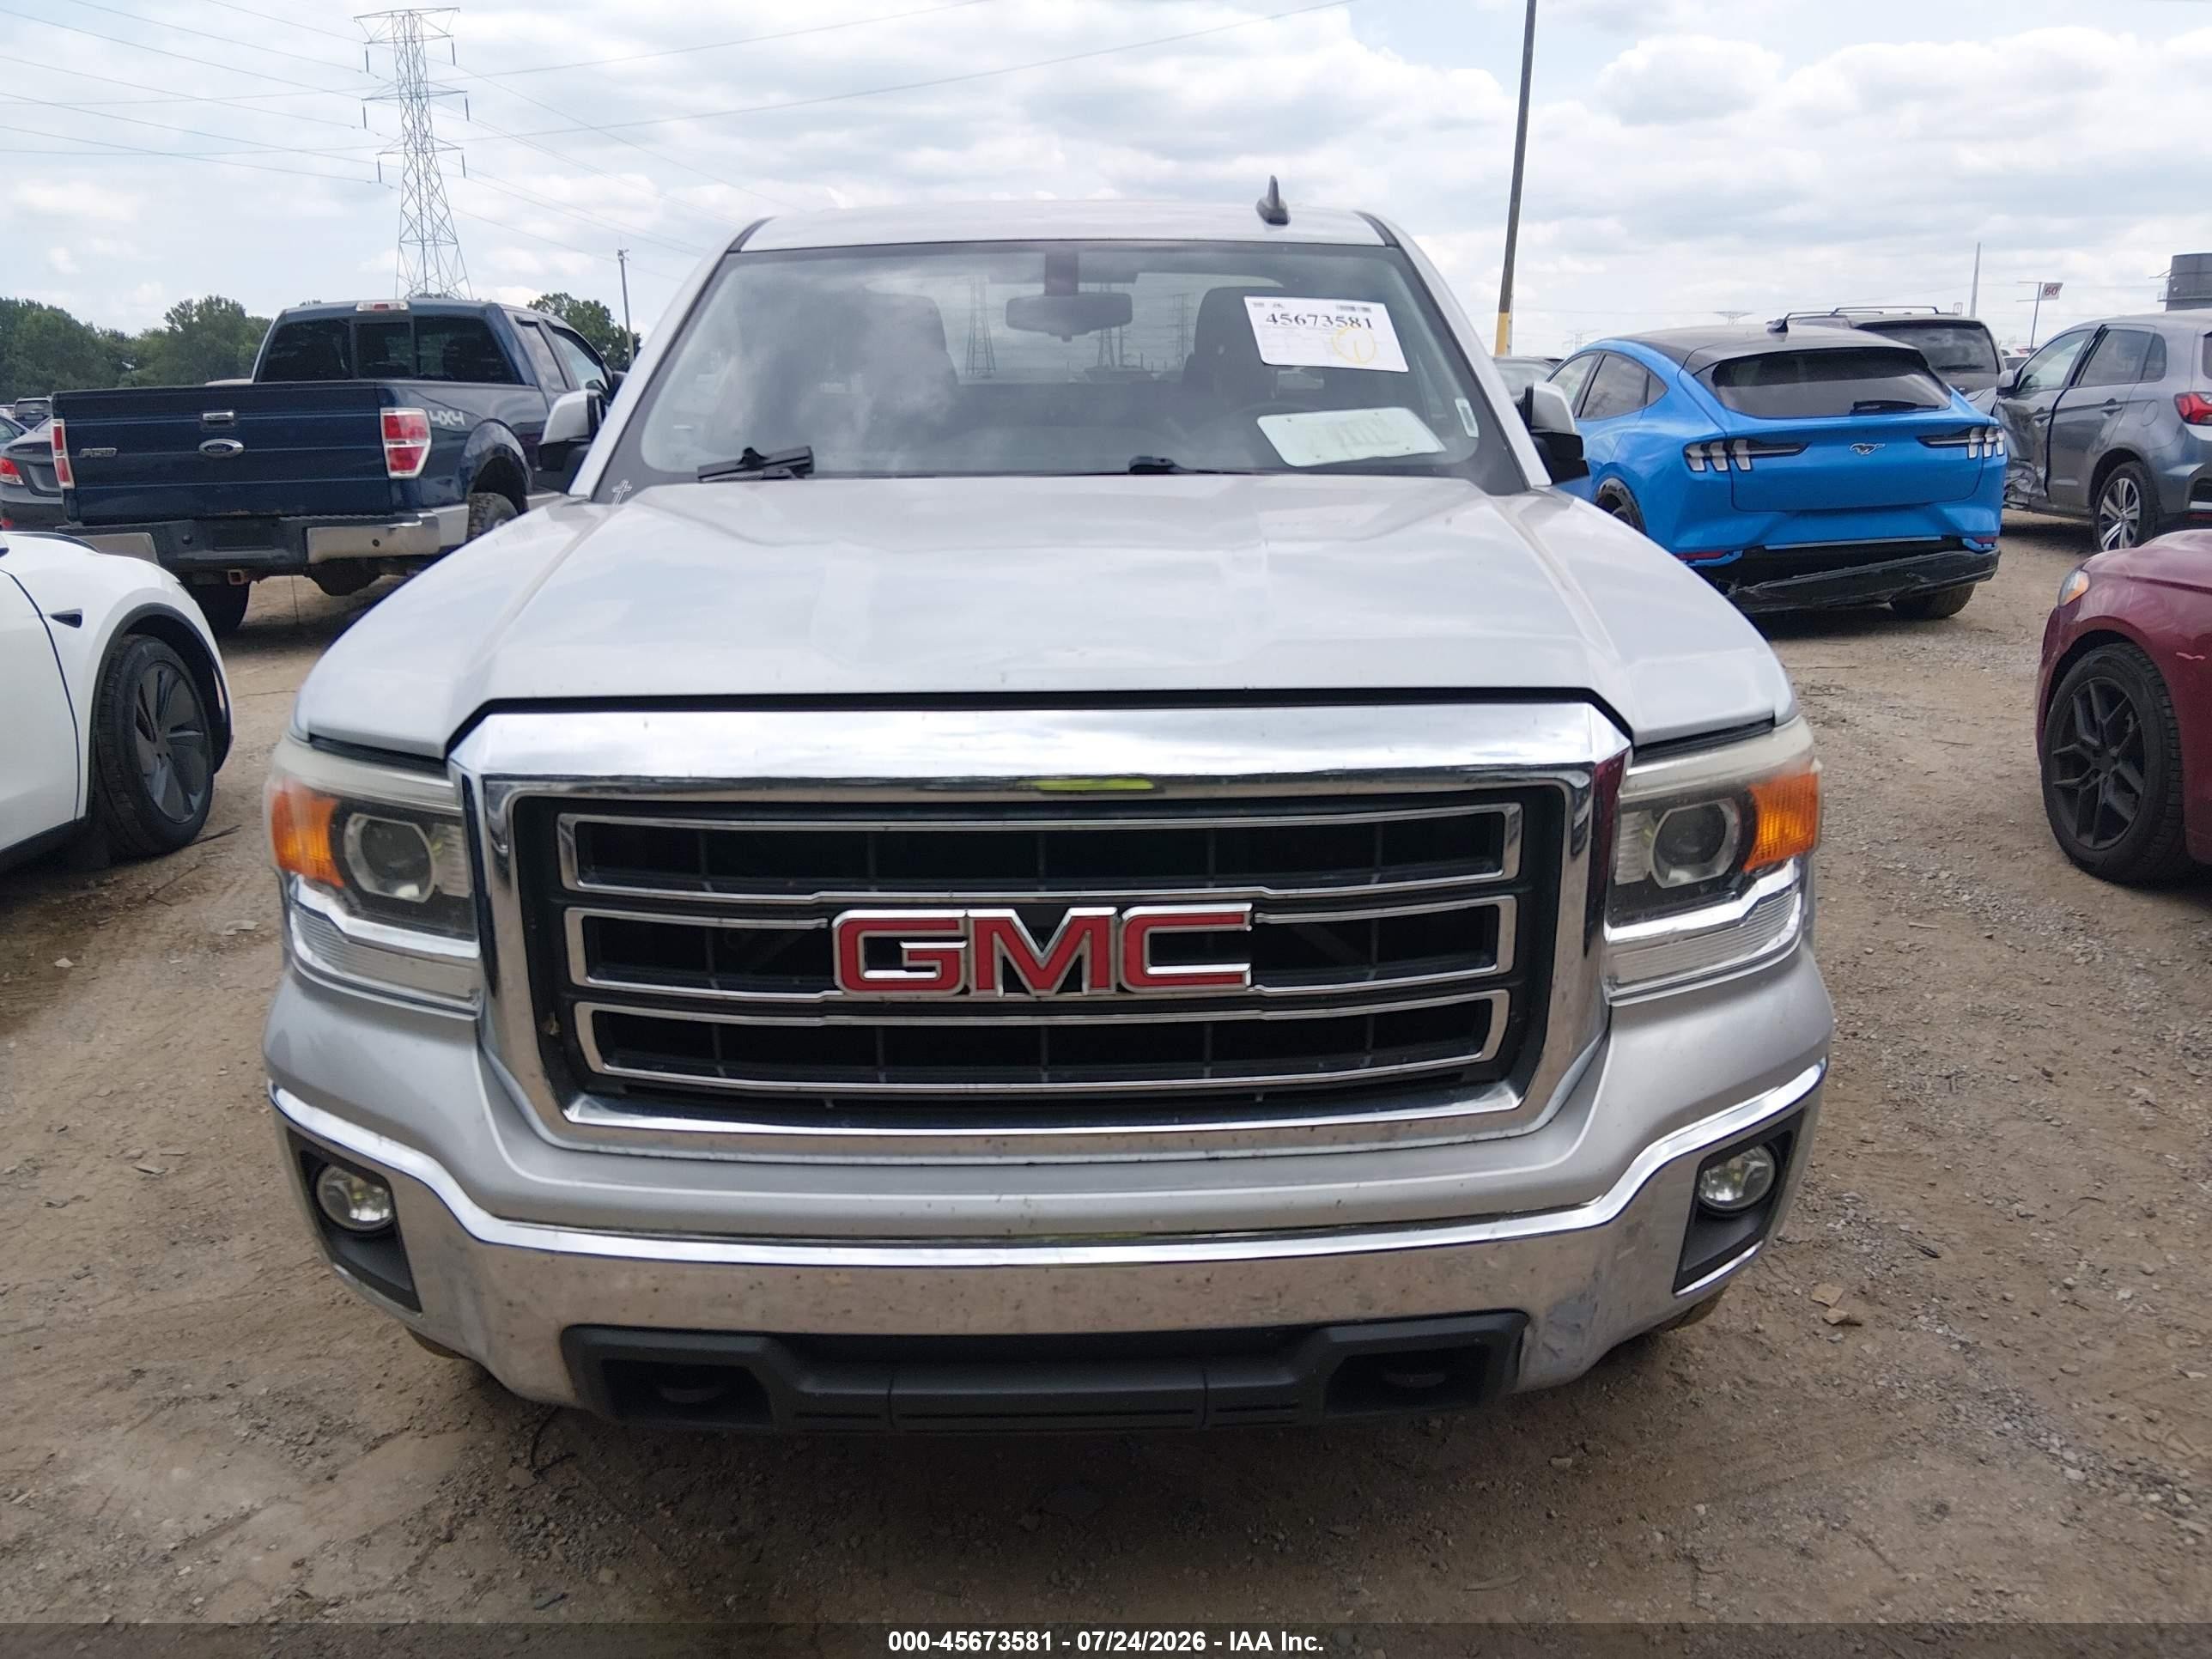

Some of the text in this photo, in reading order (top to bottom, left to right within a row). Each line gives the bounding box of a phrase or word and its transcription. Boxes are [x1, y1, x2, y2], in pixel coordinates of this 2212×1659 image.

[2045, 286, 2058, 296] 60
[1266, 313, 1373, 329] 45673581
[831, 903, 1253, 998] GMC
